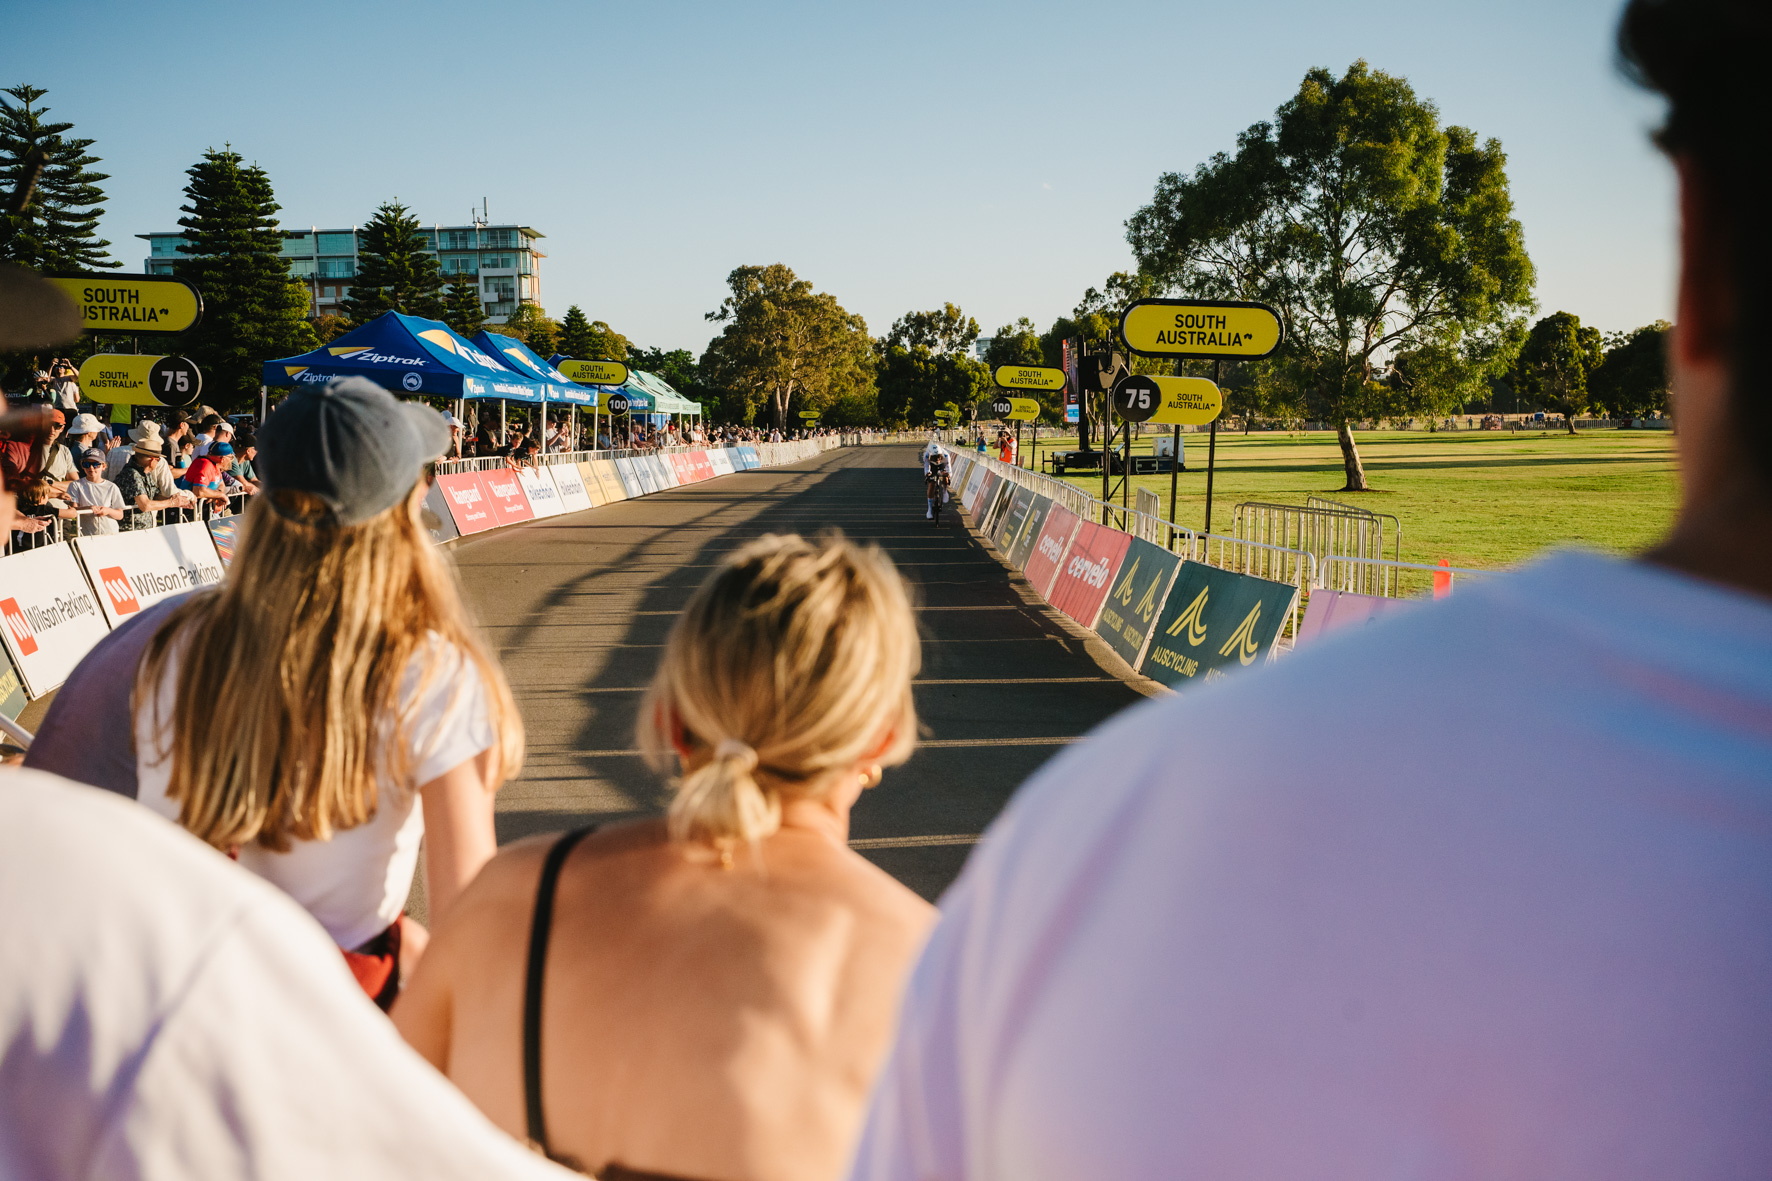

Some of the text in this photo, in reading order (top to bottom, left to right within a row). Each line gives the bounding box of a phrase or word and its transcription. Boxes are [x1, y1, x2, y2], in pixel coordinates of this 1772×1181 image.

[83, 288, 139, 304] SOUTH
[1174, 314, 1227, 330] SOUTH
[1156, 330, 1243, 347] AUSTRALIA
[357, 353, 425, 367] Ziptrak
[580, 364, 604, 372] SOUTH
[99, 371, 129, 380] SOUTH
[572, 372, 611, 380] AUSTRALIA
[1018, 370, 1042, 378] SOUTH
[89, 379, 139, 389] AUSTRALIA
[161, 370, 190, 393] 75
[1010, 377, 1049, 386] AUSTRALIA
[1125, 388, 1151, 409] 75
[1177, 393, 1203, 402] SOUTH
[609, 400, 627, 410] 100
[992, 402, 1011, 413] 100
[1167, 401, 1211, 411] AUSTRALIA
[130, 563, 220, 597] Wilson Parking
[24, 591, 95, 634] Wilson Parking
[1151, 646, 1199, 677] AUSCYCLING
